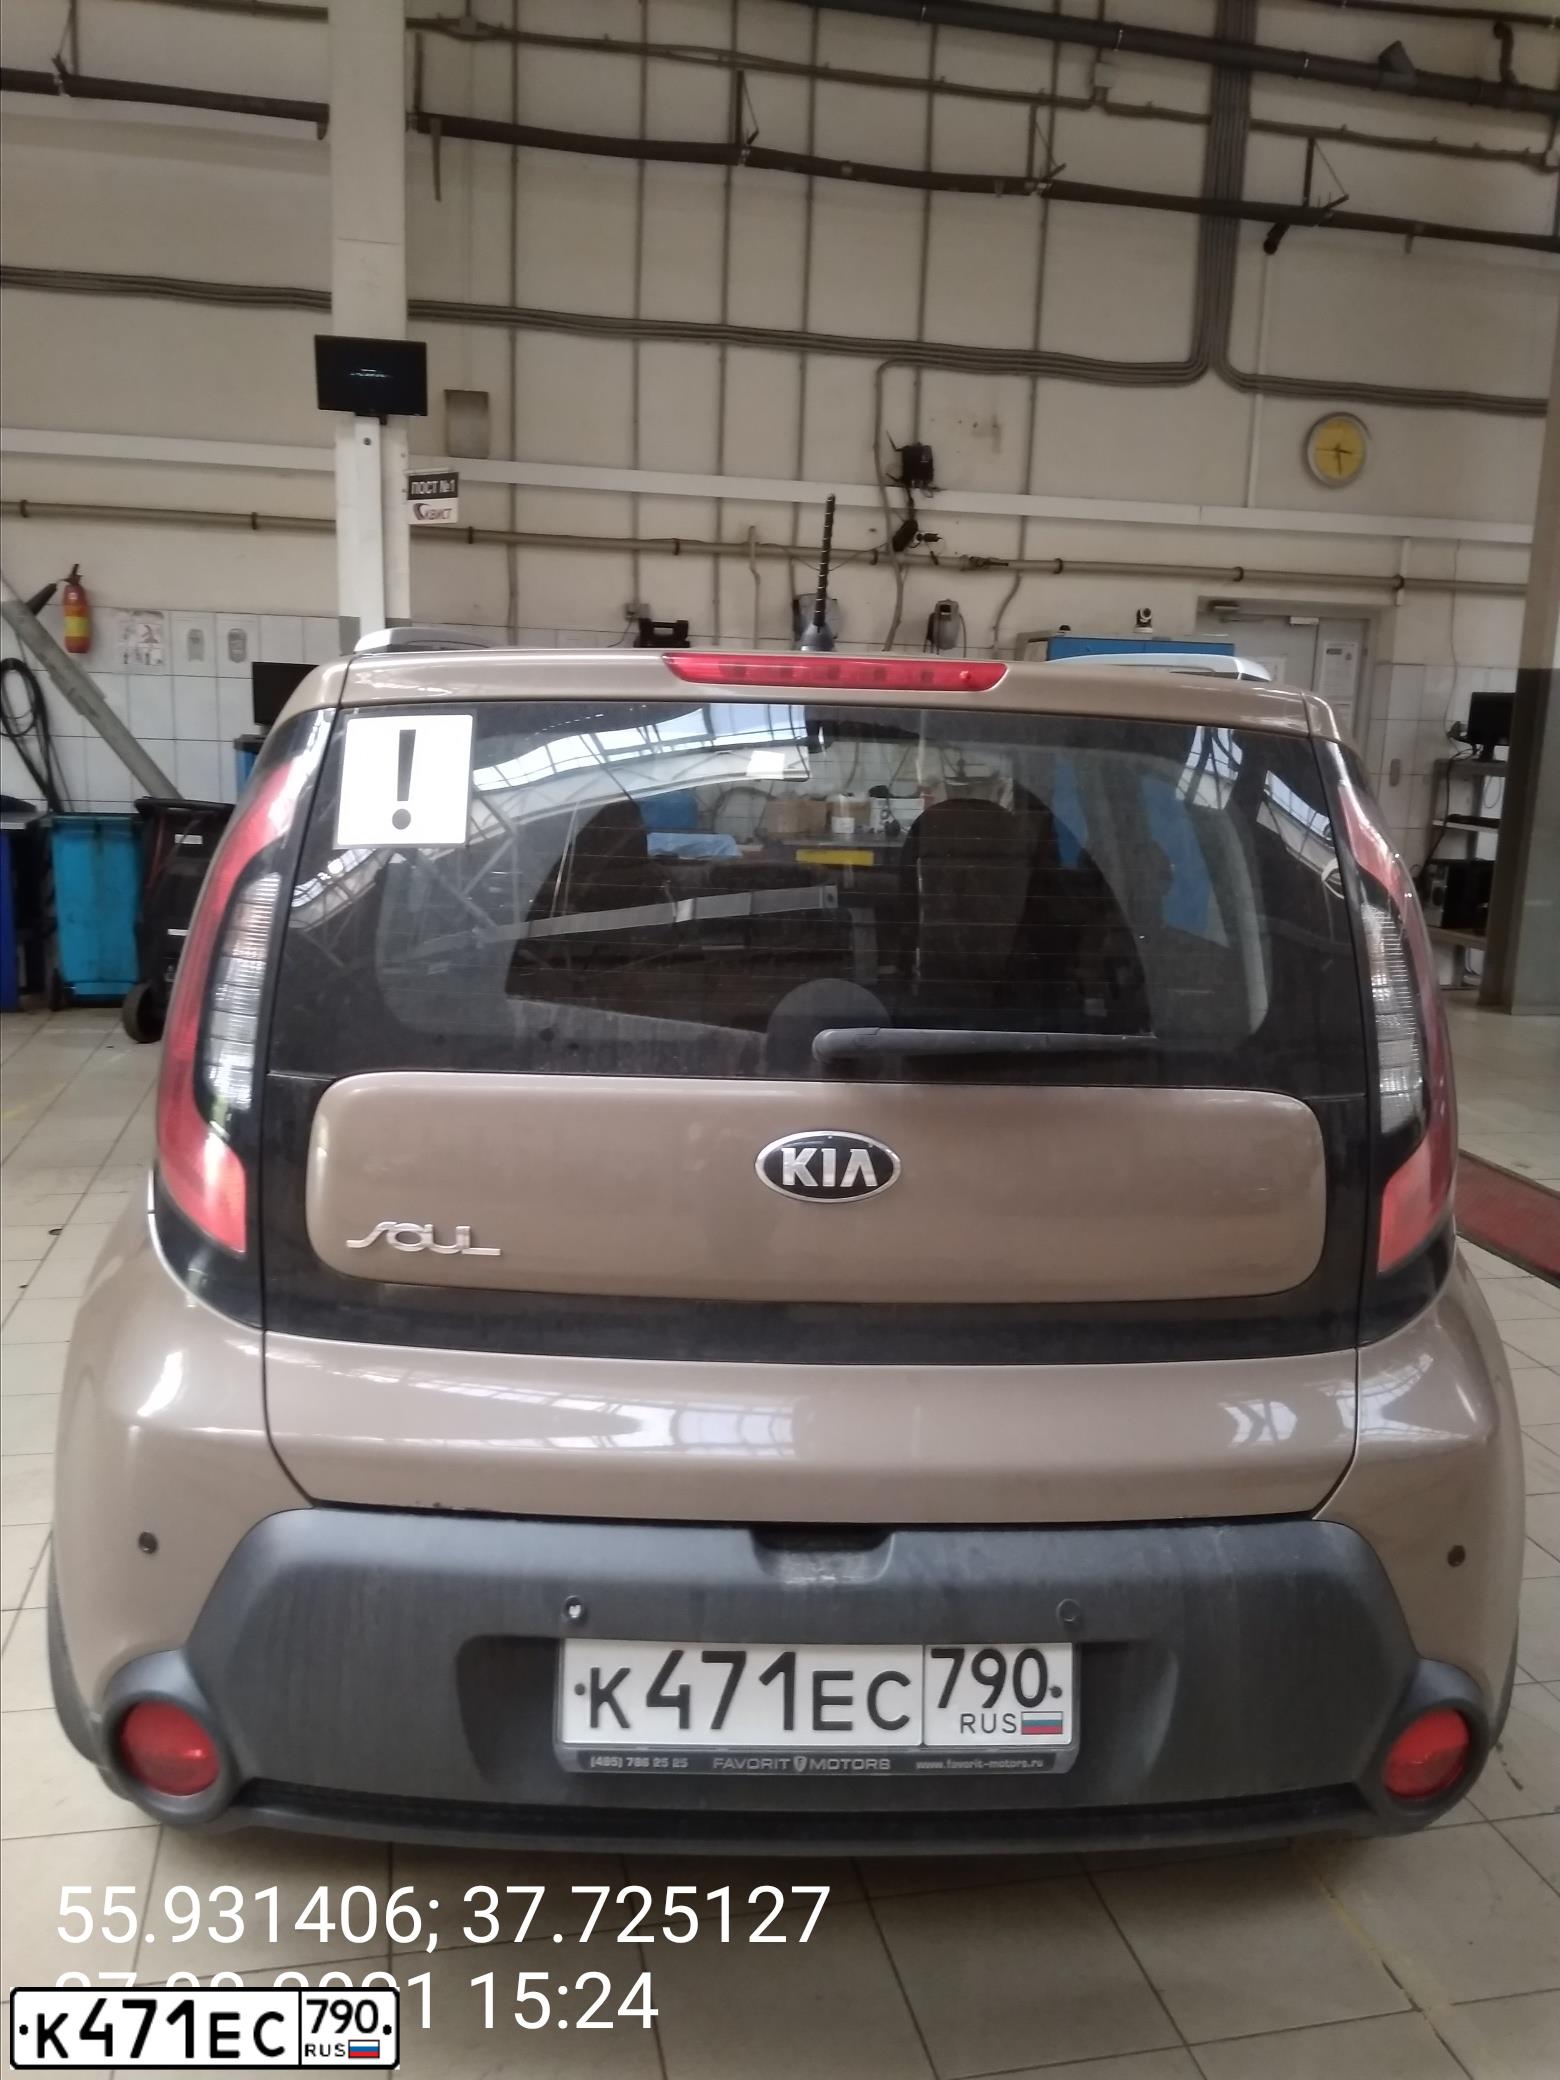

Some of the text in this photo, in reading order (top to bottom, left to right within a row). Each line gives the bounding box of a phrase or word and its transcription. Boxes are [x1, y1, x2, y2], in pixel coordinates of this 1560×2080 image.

[411, 479, 456, 495] ПОСТ №1
[781, 1147, 878, 1187] KIA
[346, 1221, 501, 1256] SOUL
[930, 1648, 1049, 1709] 790
[960, 1713, 1018, 1734] RUS
[712, 1757, 891, 1770] FAVORIT MOTORS
